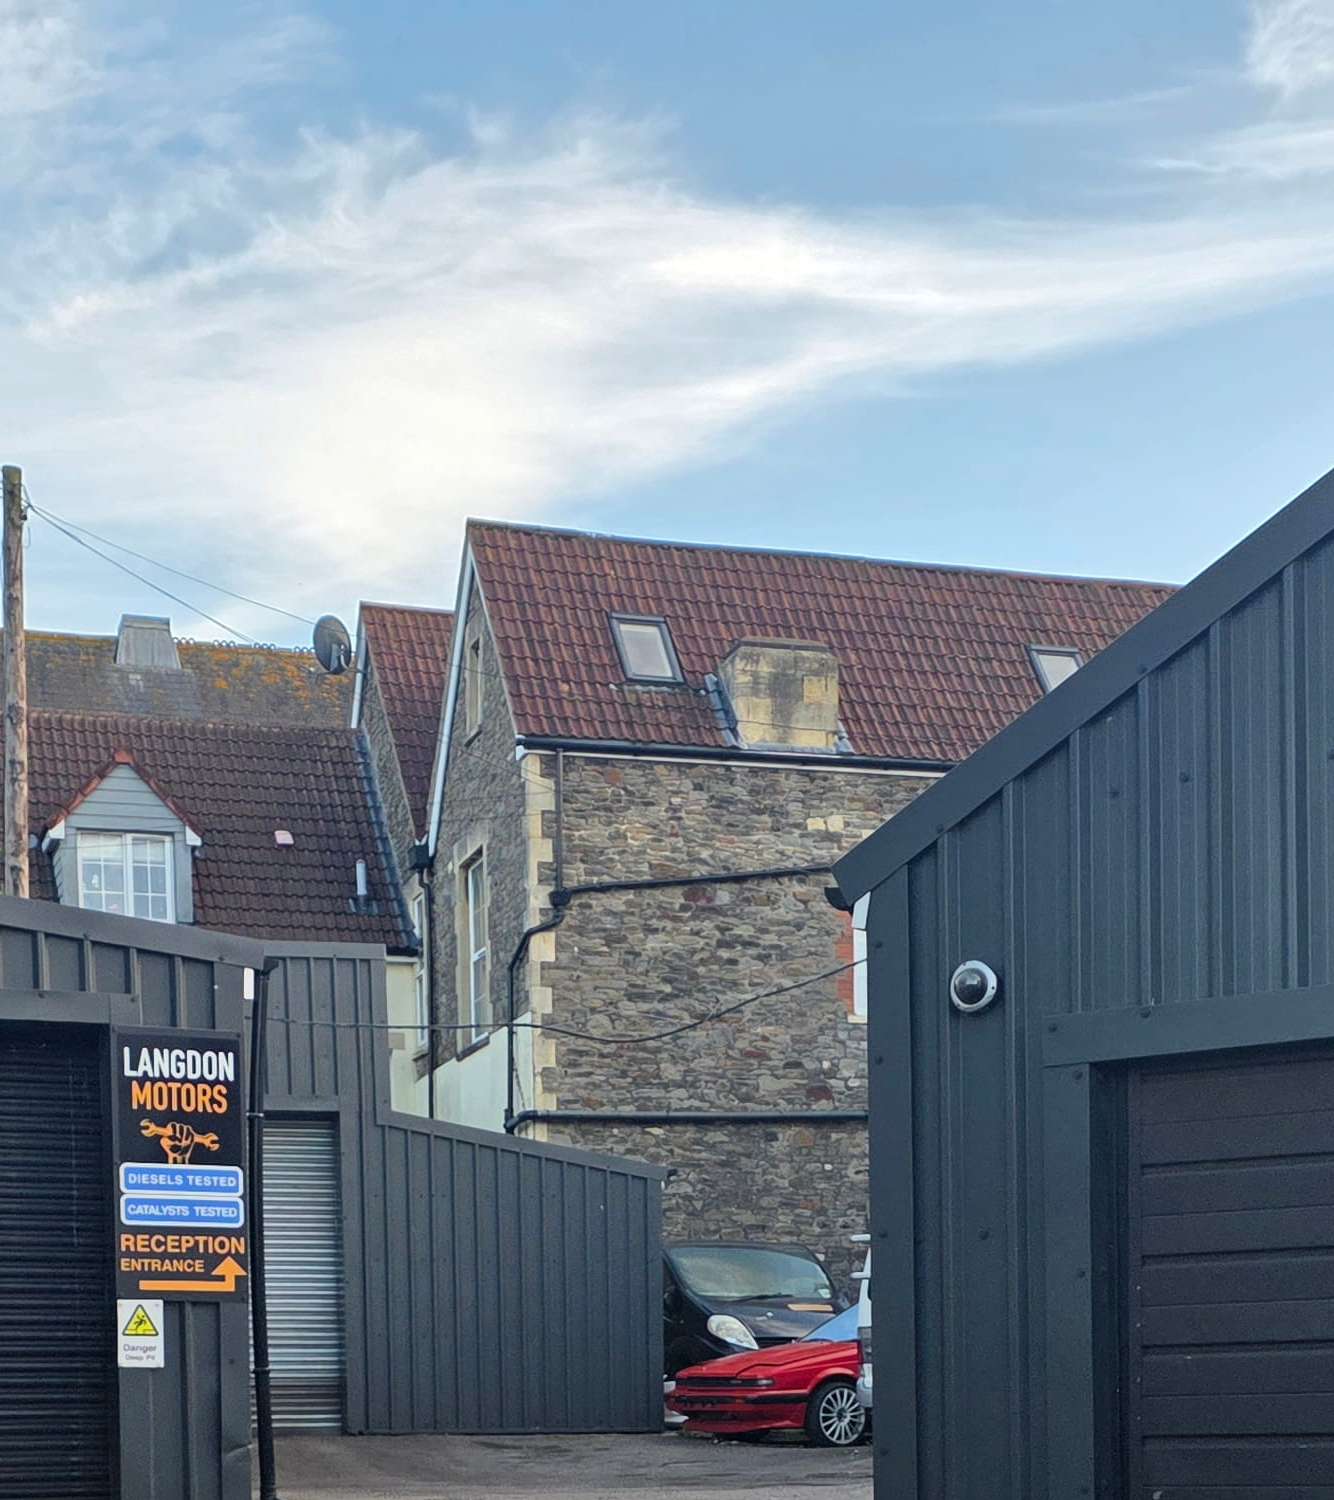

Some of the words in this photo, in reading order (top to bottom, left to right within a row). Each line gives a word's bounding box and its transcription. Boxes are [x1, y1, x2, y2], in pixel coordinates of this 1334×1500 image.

[123, 1046, 235, 1082] LANGDON
[131, 1080, 228, 1114] MOTORS
[128, 1173, 183, 1186] DIESELS
[186, 1175, 237, 1188] TESTED
[127, 1204, 190, 1217] CATALYSTS
[193, 1206, 238, 1218] TESTED
[120, 1233, 245, 1255] RECEPTION
[120, 1257, 205, 1273] ENTRANCE
[123, 1343, 157, 1354] Danger
